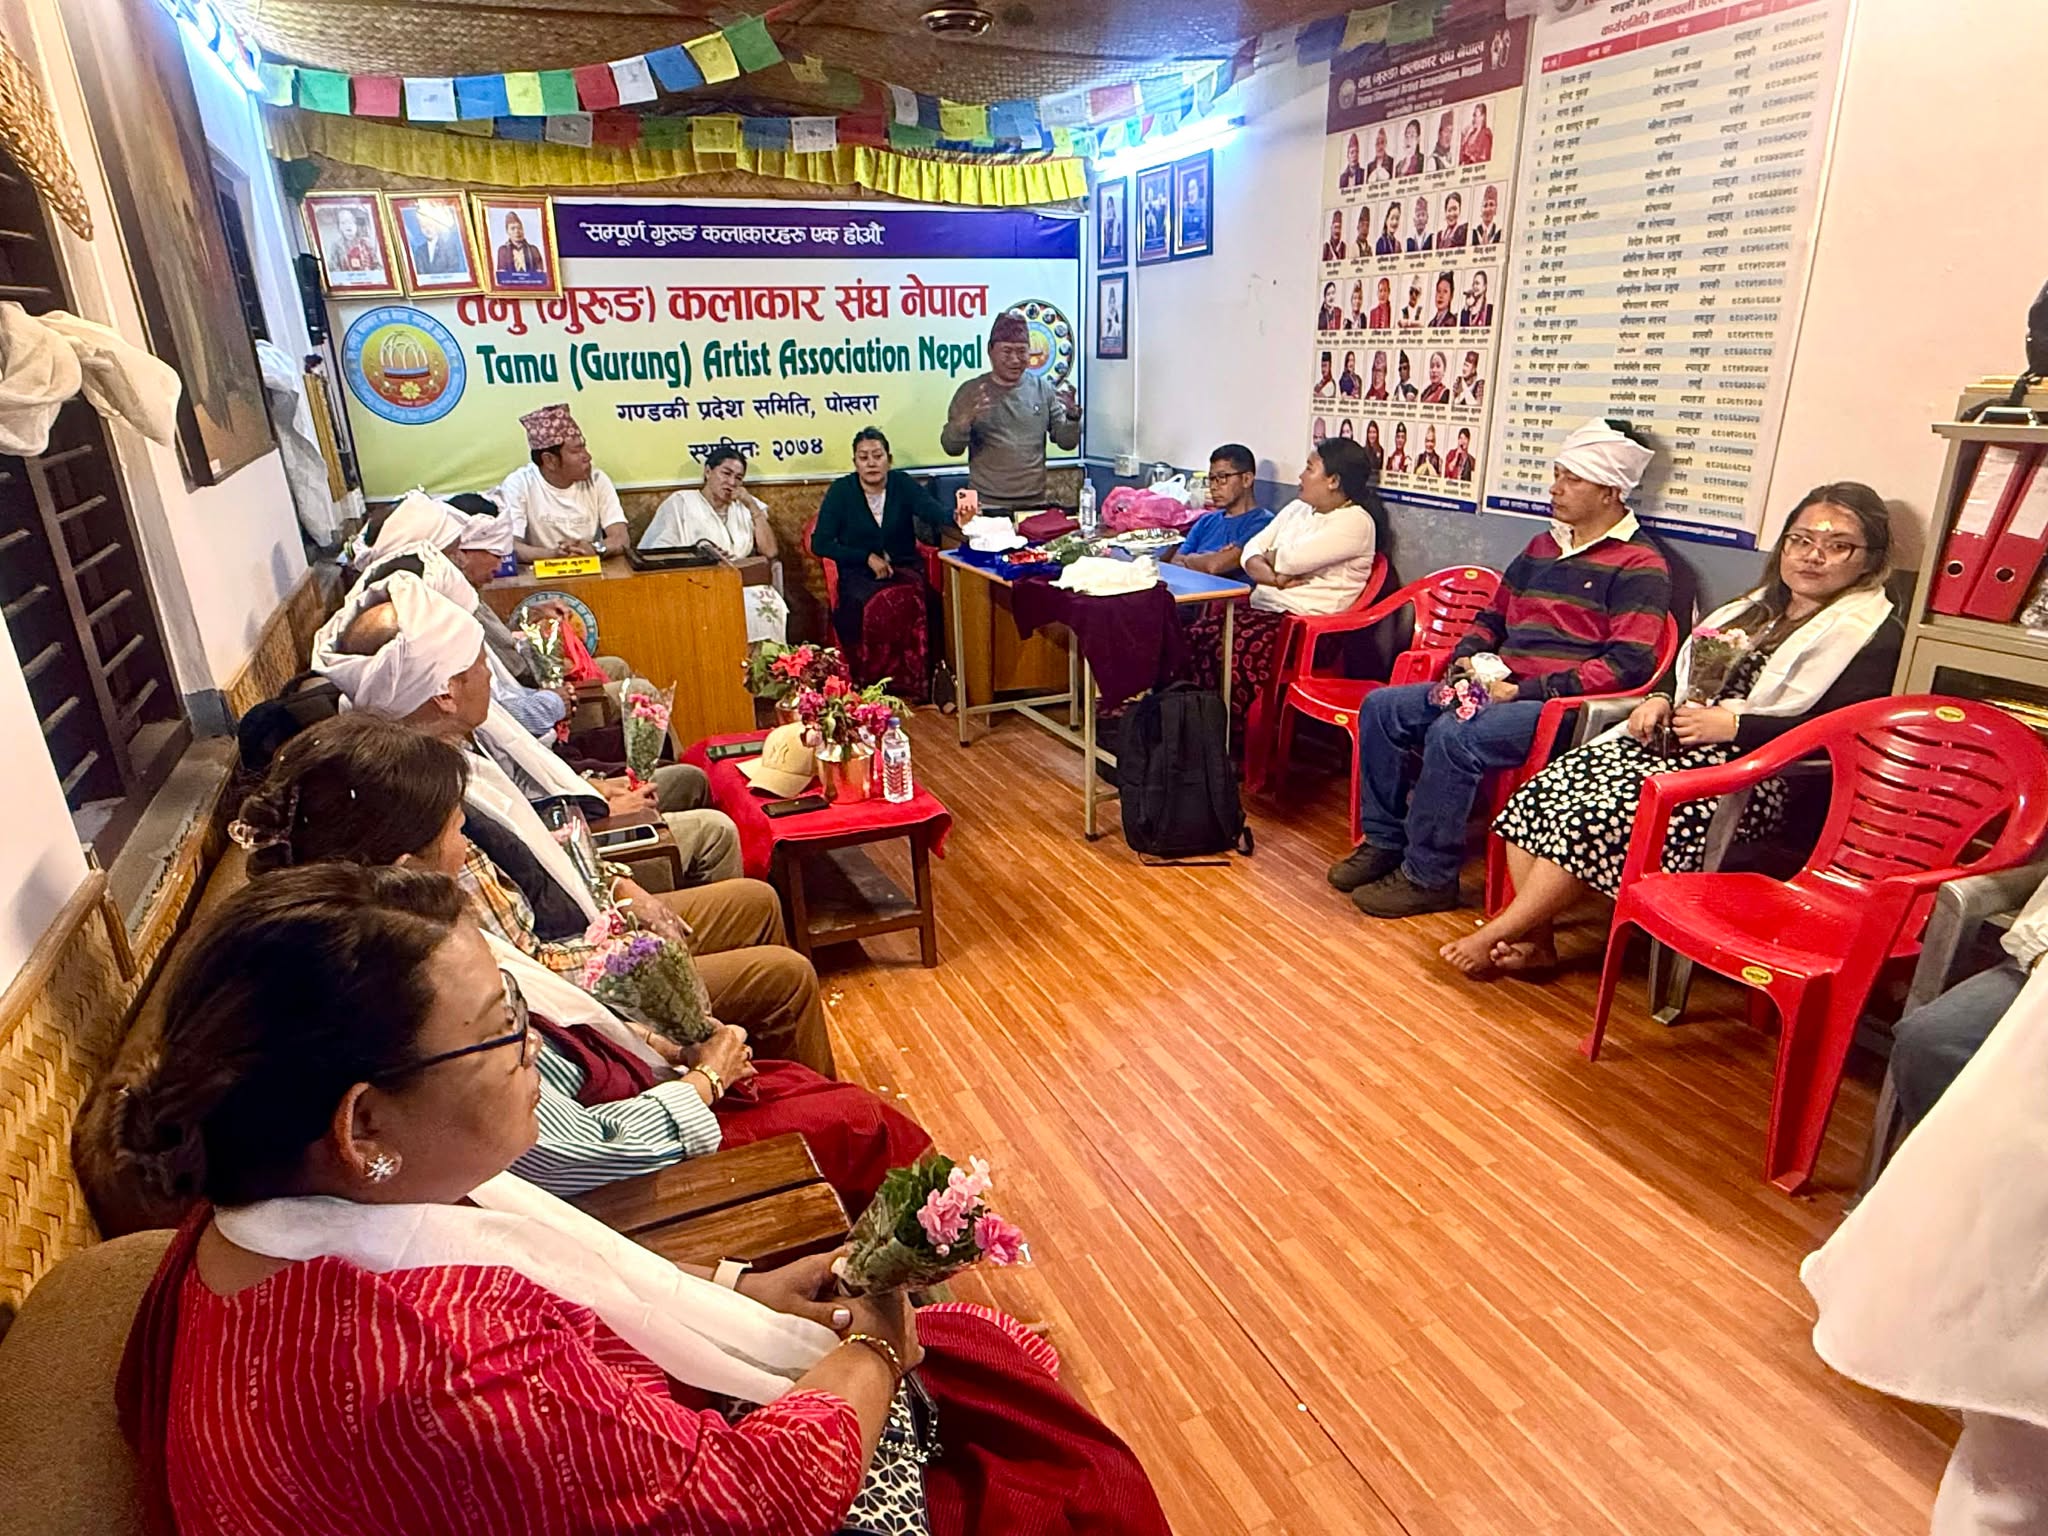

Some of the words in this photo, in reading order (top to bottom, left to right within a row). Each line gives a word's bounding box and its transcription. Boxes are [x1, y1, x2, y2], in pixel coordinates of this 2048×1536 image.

[810, 225, 840, 245] एक
[666, 285, 826, 323] कलाकार
[834, 277, 891, 322] संघ
[899, 273, 990, 318] नेपाल
[476, 345, 559, 384] Tamu
[570, 341, 692, 392] (Gurung)
[703, 339, 772, 382] Artist
[779, 337, 911, 381] Association
[918, 334, 982, 378] Nepal
[616, 396, 690, 422] गण्डकी
[697, 395, 745, 421] प्रदेश
[824, 391, 880, 416] पोखरा
[772, 438, 824, 461] २०७४
